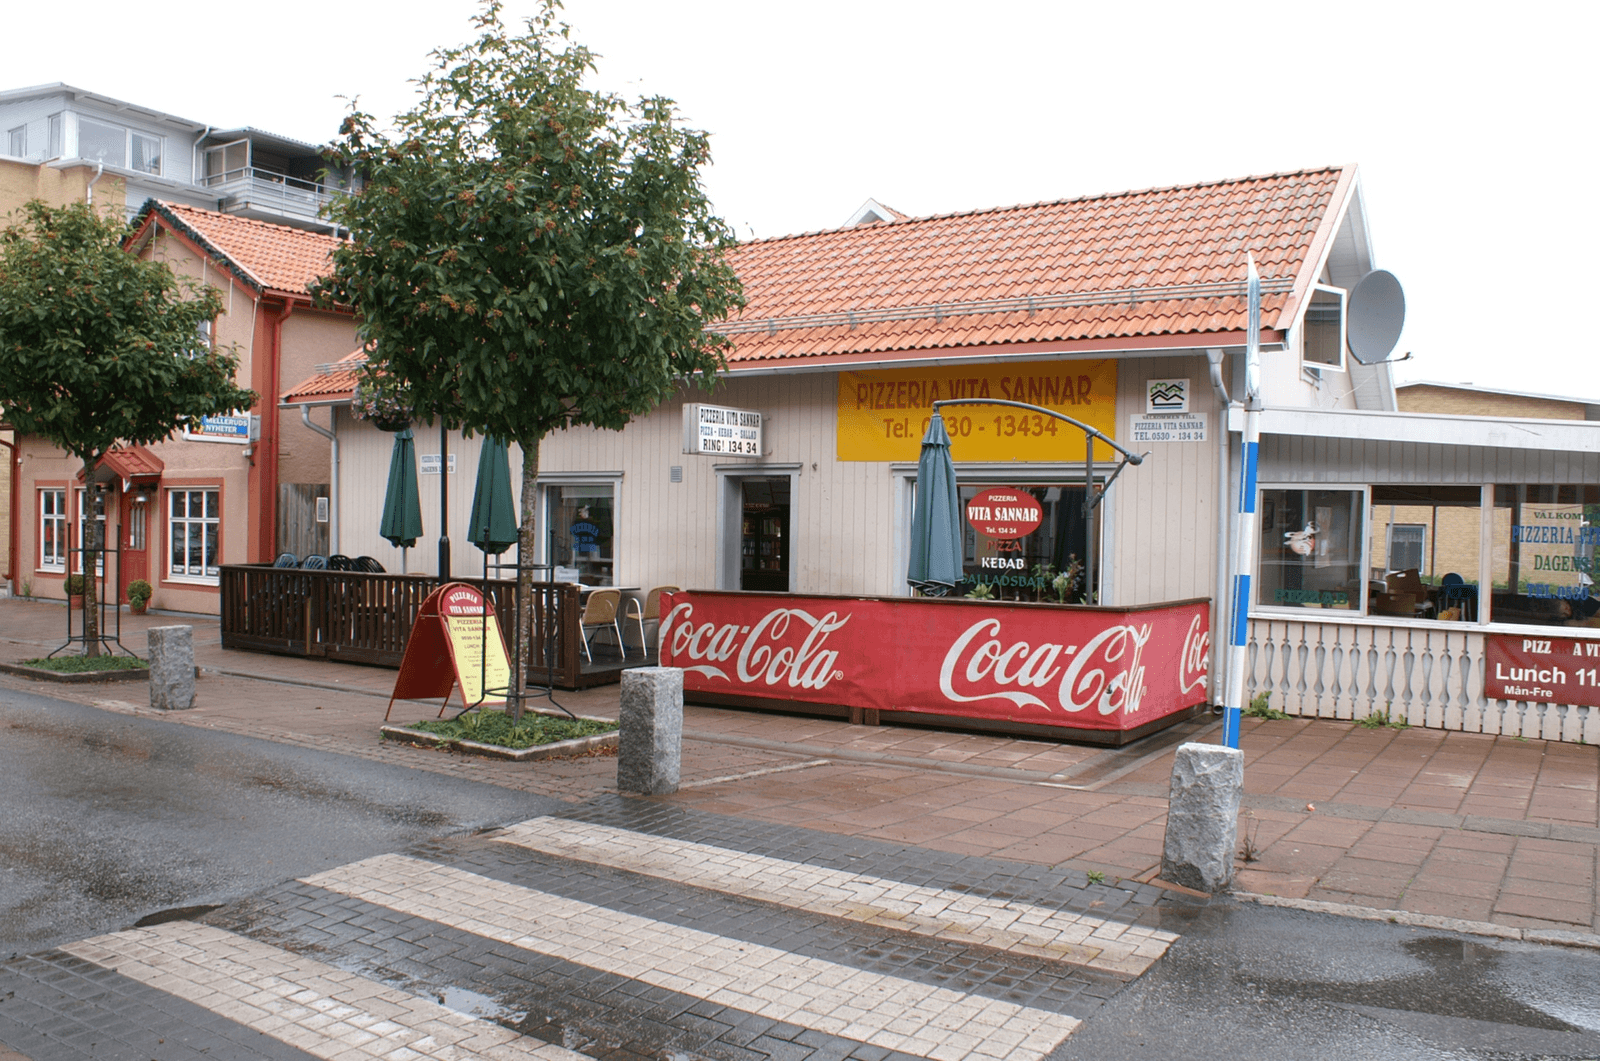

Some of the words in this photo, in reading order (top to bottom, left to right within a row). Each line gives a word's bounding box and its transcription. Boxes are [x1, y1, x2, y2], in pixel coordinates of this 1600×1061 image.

[857, 380, 940, 409] PIZZERIA
[949, 378, 991, 405] VITA
[1000, 375, 1092, 406] SANNAR
[700, 408, 725, 424] PIZZERIA
[726, 411, 738, 425] VITA
[740, 413, 760, 428] SANNAR
[1134, 422, 1162, 430] PIZZERIA
[1164, 422, 1177, 430] VITA
[1179, 421, 1204, 429] SANNAR
[205, 425, 238, 434] NYHETER
[700, 426, 713, 436] PIZZA
[718, 427, 732, 437] KEBAB
[740, 430, 757, 440] SALLAD
[883, 417, 914, 438] Tel.
[921, 416, 971, 437] 030
[993, 415, 1059, 437] 13434
[1178, 432, 1191, 440] 134
[1194, 432, 1204, 440] 34
[703, 438, 725, 452] RING!
[729, 440, 743, 453] 134
[746, 442, 757, 454] 34
[968, 506, 992, 521] VITA
[994, 507, 1039, 522] SANNAR
[985, 526, 996, 534] Tel.
[1512, 525, 1574, 544] PIZZERIA
[987, 540, 1022, 552] PIZZA
[981, 557, 1024, 570] KEBAB
[1534, 554, 1591, 573] DAGENS
[449, 591, 478, 604] PIZZERIA
[449, 605, 463, 614] VITA
[658, 602, 852, 690] Coca-Cola
[939, 618, 1153, 717] Coca-Cola
[1496, 662, 1566, 684] Lunch
[1504, 685, 1553, 697] Mån-Fre
